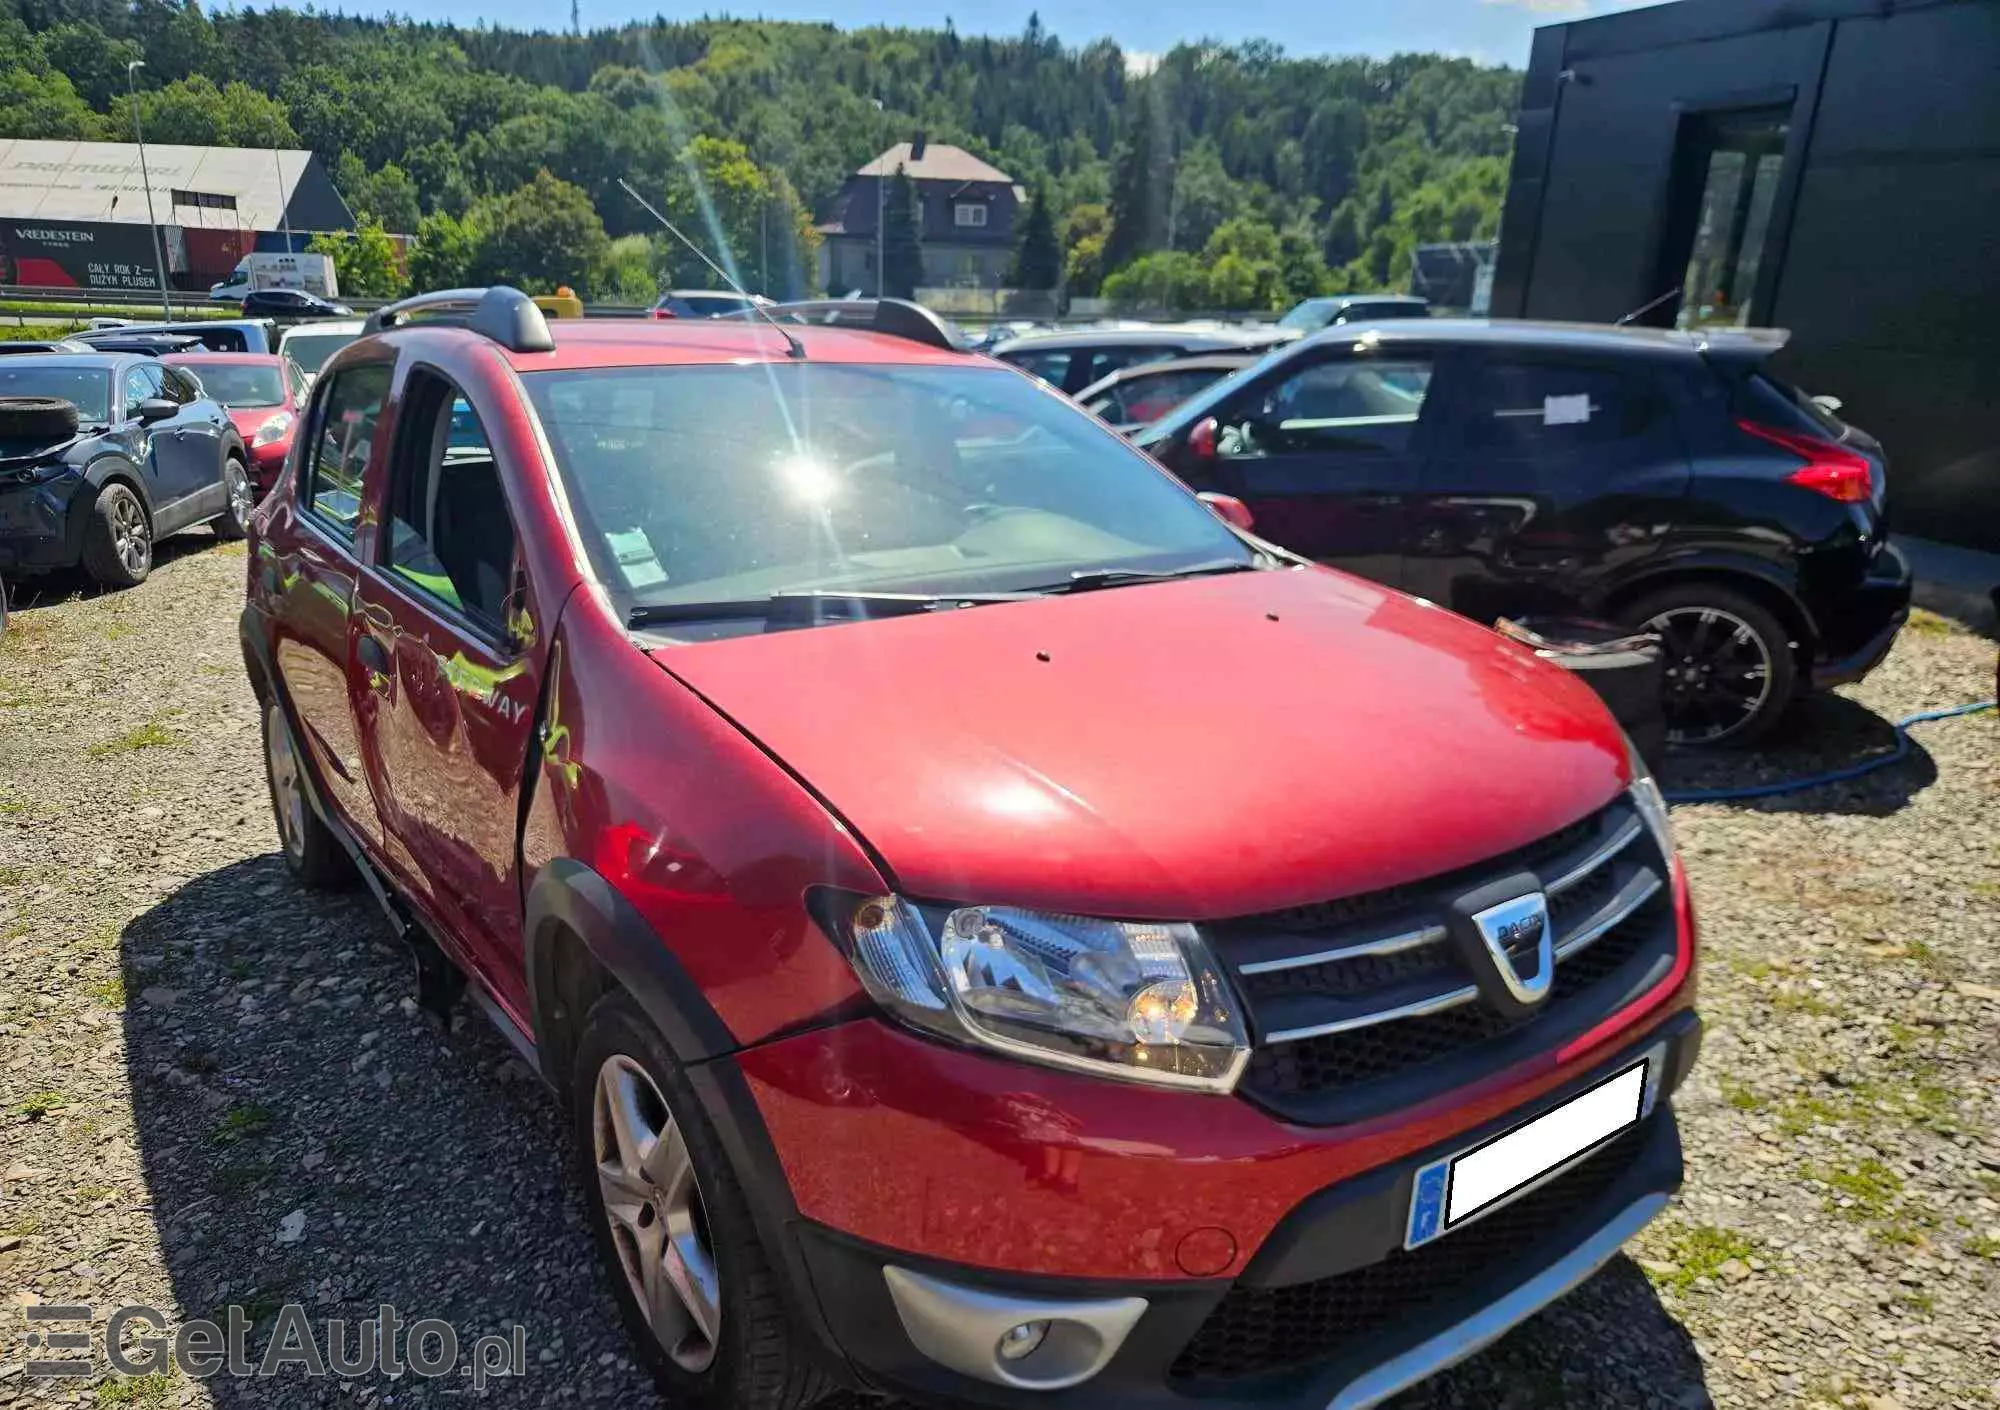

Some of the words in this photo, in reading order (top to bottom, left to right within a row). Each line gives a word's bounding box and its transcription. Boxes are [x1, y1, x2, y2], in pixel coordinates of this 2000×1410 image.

[16, 229, 94, 242] VREDESTEIN
[114, 264, 130, 274] ROK
[122, 275, 156, 287] PLUSEM
